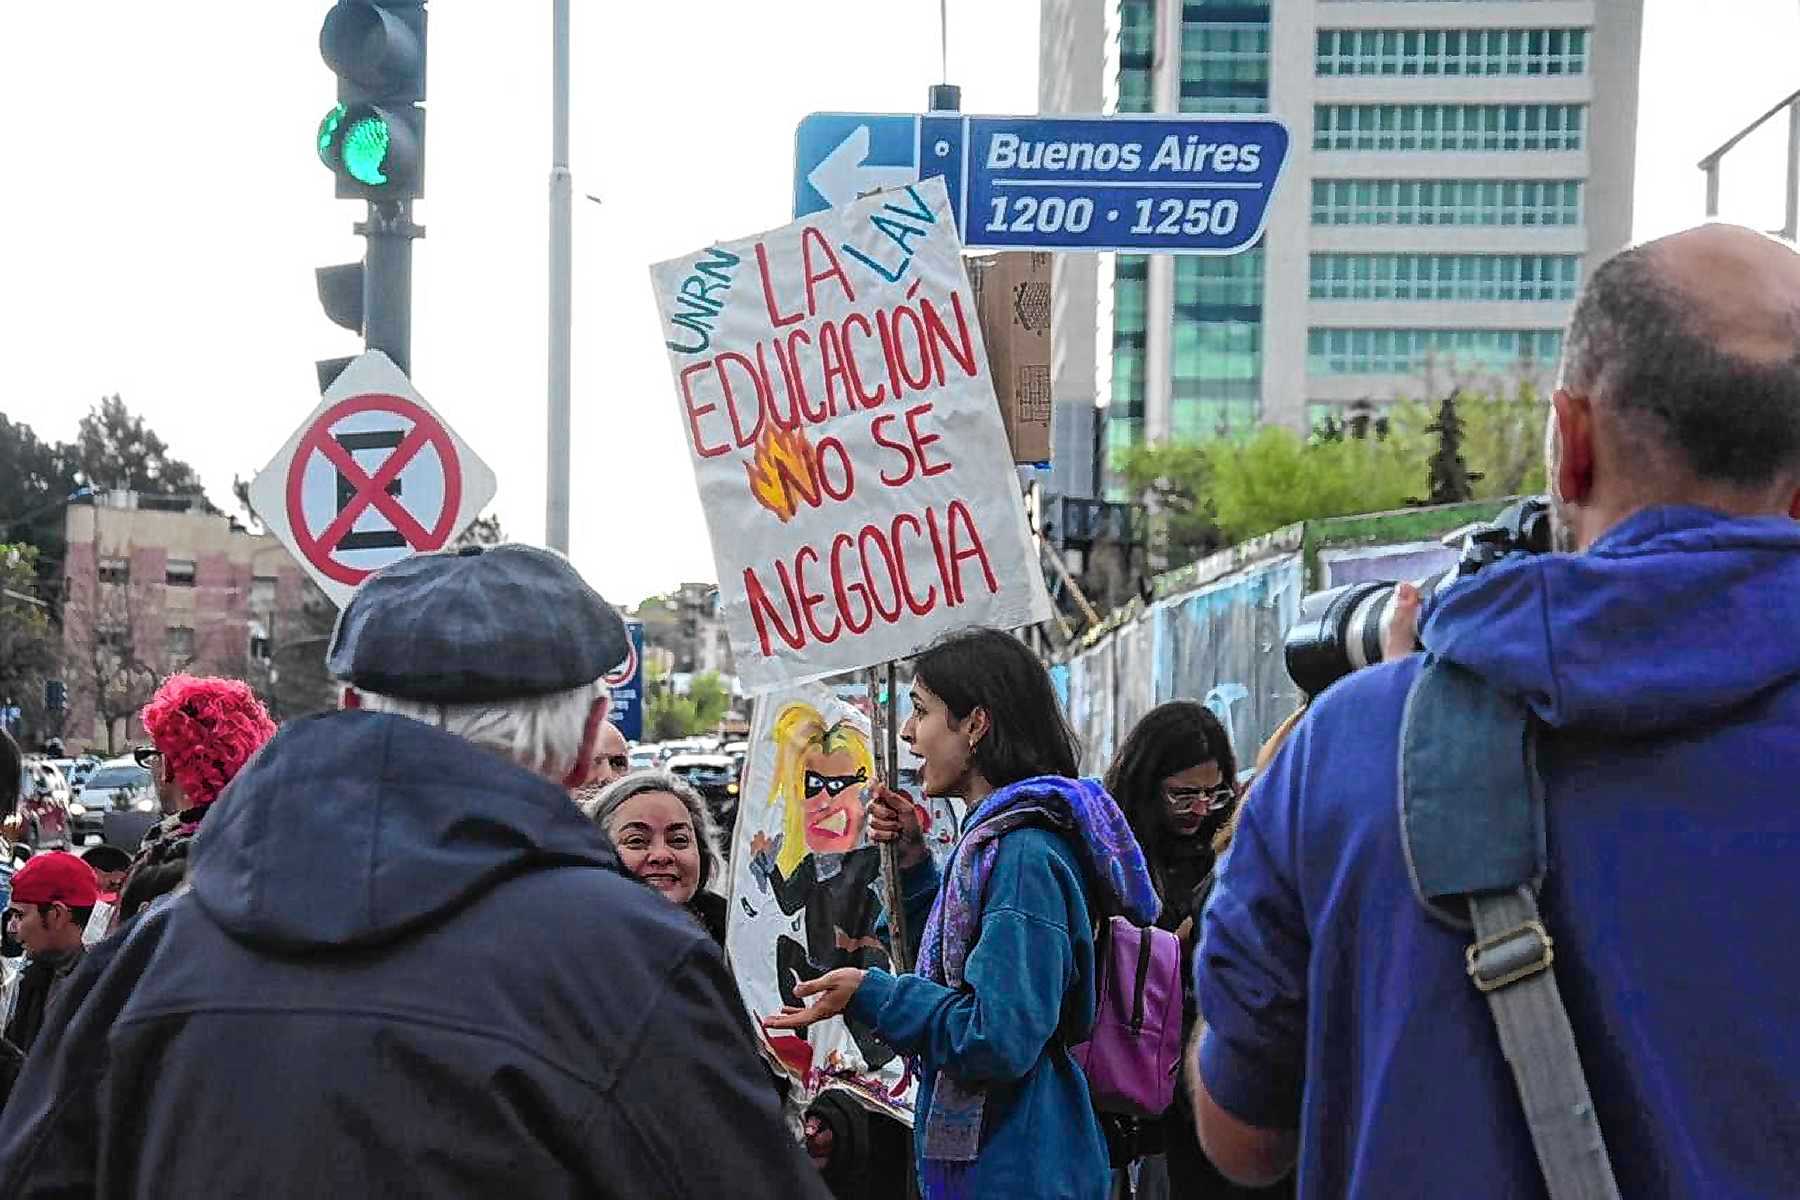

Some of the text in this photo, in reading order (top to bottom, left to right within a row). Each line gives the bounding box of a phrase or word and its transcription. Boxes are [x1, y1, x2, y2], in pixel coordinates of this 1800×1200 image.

[986, 132, 1263, 173] Buenos Aires
[985, 195, 1095, 234] 1200
[1129, 197, 1240, 236] 1250
[666, 247, 741, 354] UNRN
[754, 226, 856, 329] LA
[679, 277, 978, 459] EDUCACIÓN
[773, 402, 952, 517] NO SE
[743, 499, 1000, 657] NEGOCIA
